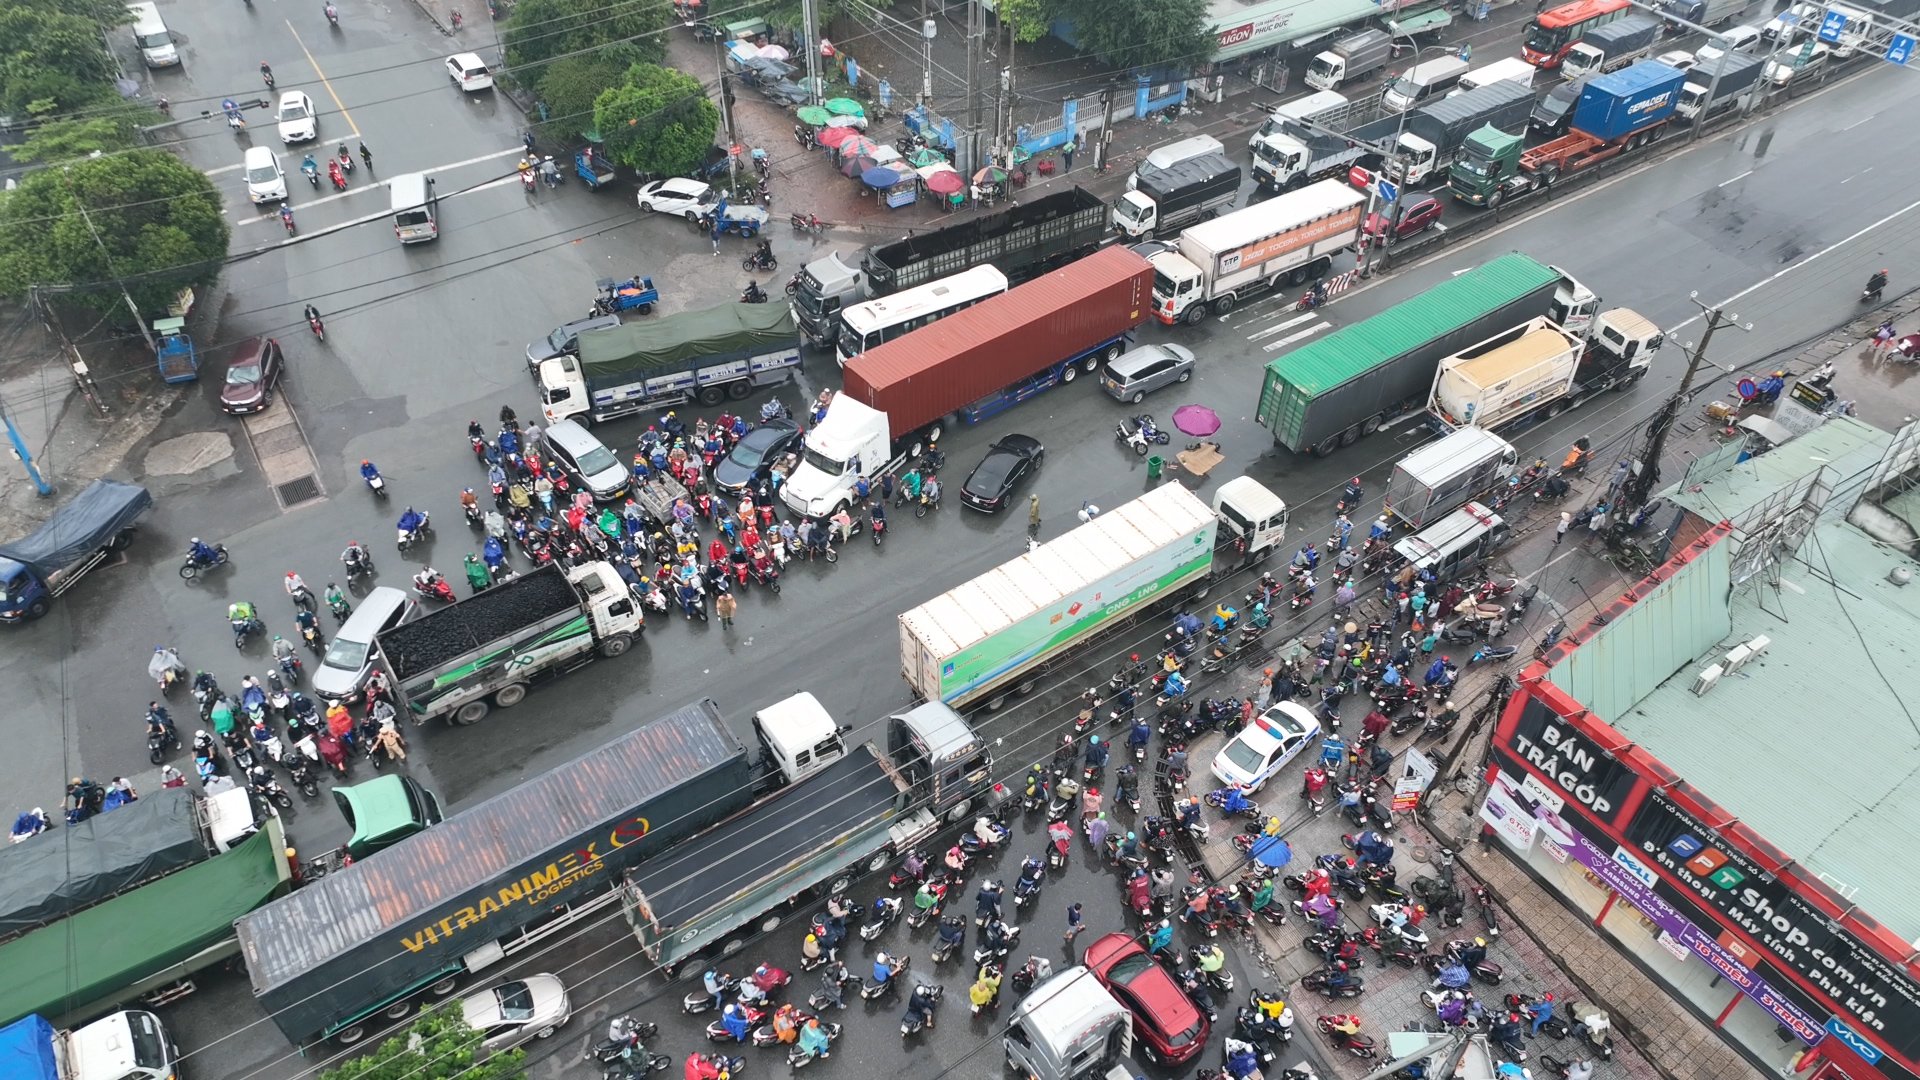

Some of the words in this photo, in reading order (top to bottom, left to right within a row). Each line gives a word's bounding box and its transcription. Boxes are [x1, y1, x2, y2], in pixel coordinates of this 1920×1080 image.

[1105, 598, 1131, 616] CNG
[1137, 582, 1159, 600] LNG
[1542, 724, 1595, 774] BÁN
[1526, 780, 1560, 807] SONY
[527, 859, 605, 907] LOGISTICS
[1580, 837, 1612, 866] Galaxy
[1618, 866, 1644, 891] Fold4
[1602, 867, 1640, 900] SAMSUNG
[1617, 852, 1652, 884] DELL
[400, 841, 603, 954] VITRANIMEX
[1677, 866, 1717, 901] thoại
[1727, 906, 1762, 934] Máy
[1763, 933, 1796, 963] tính
[1808, 968, 1843, 999] Phụ
[1845, 996, 1886, 1032] kiện
[1694, 939, 1711, 957] 16
[1711, 951, 1753, 988] TRIỆU
[1760, 993, 1773, 1006] 3
[1773, 1001, 1817, 1041] TRIỆU
[1834, 1022, 1877, 1059] vivo
